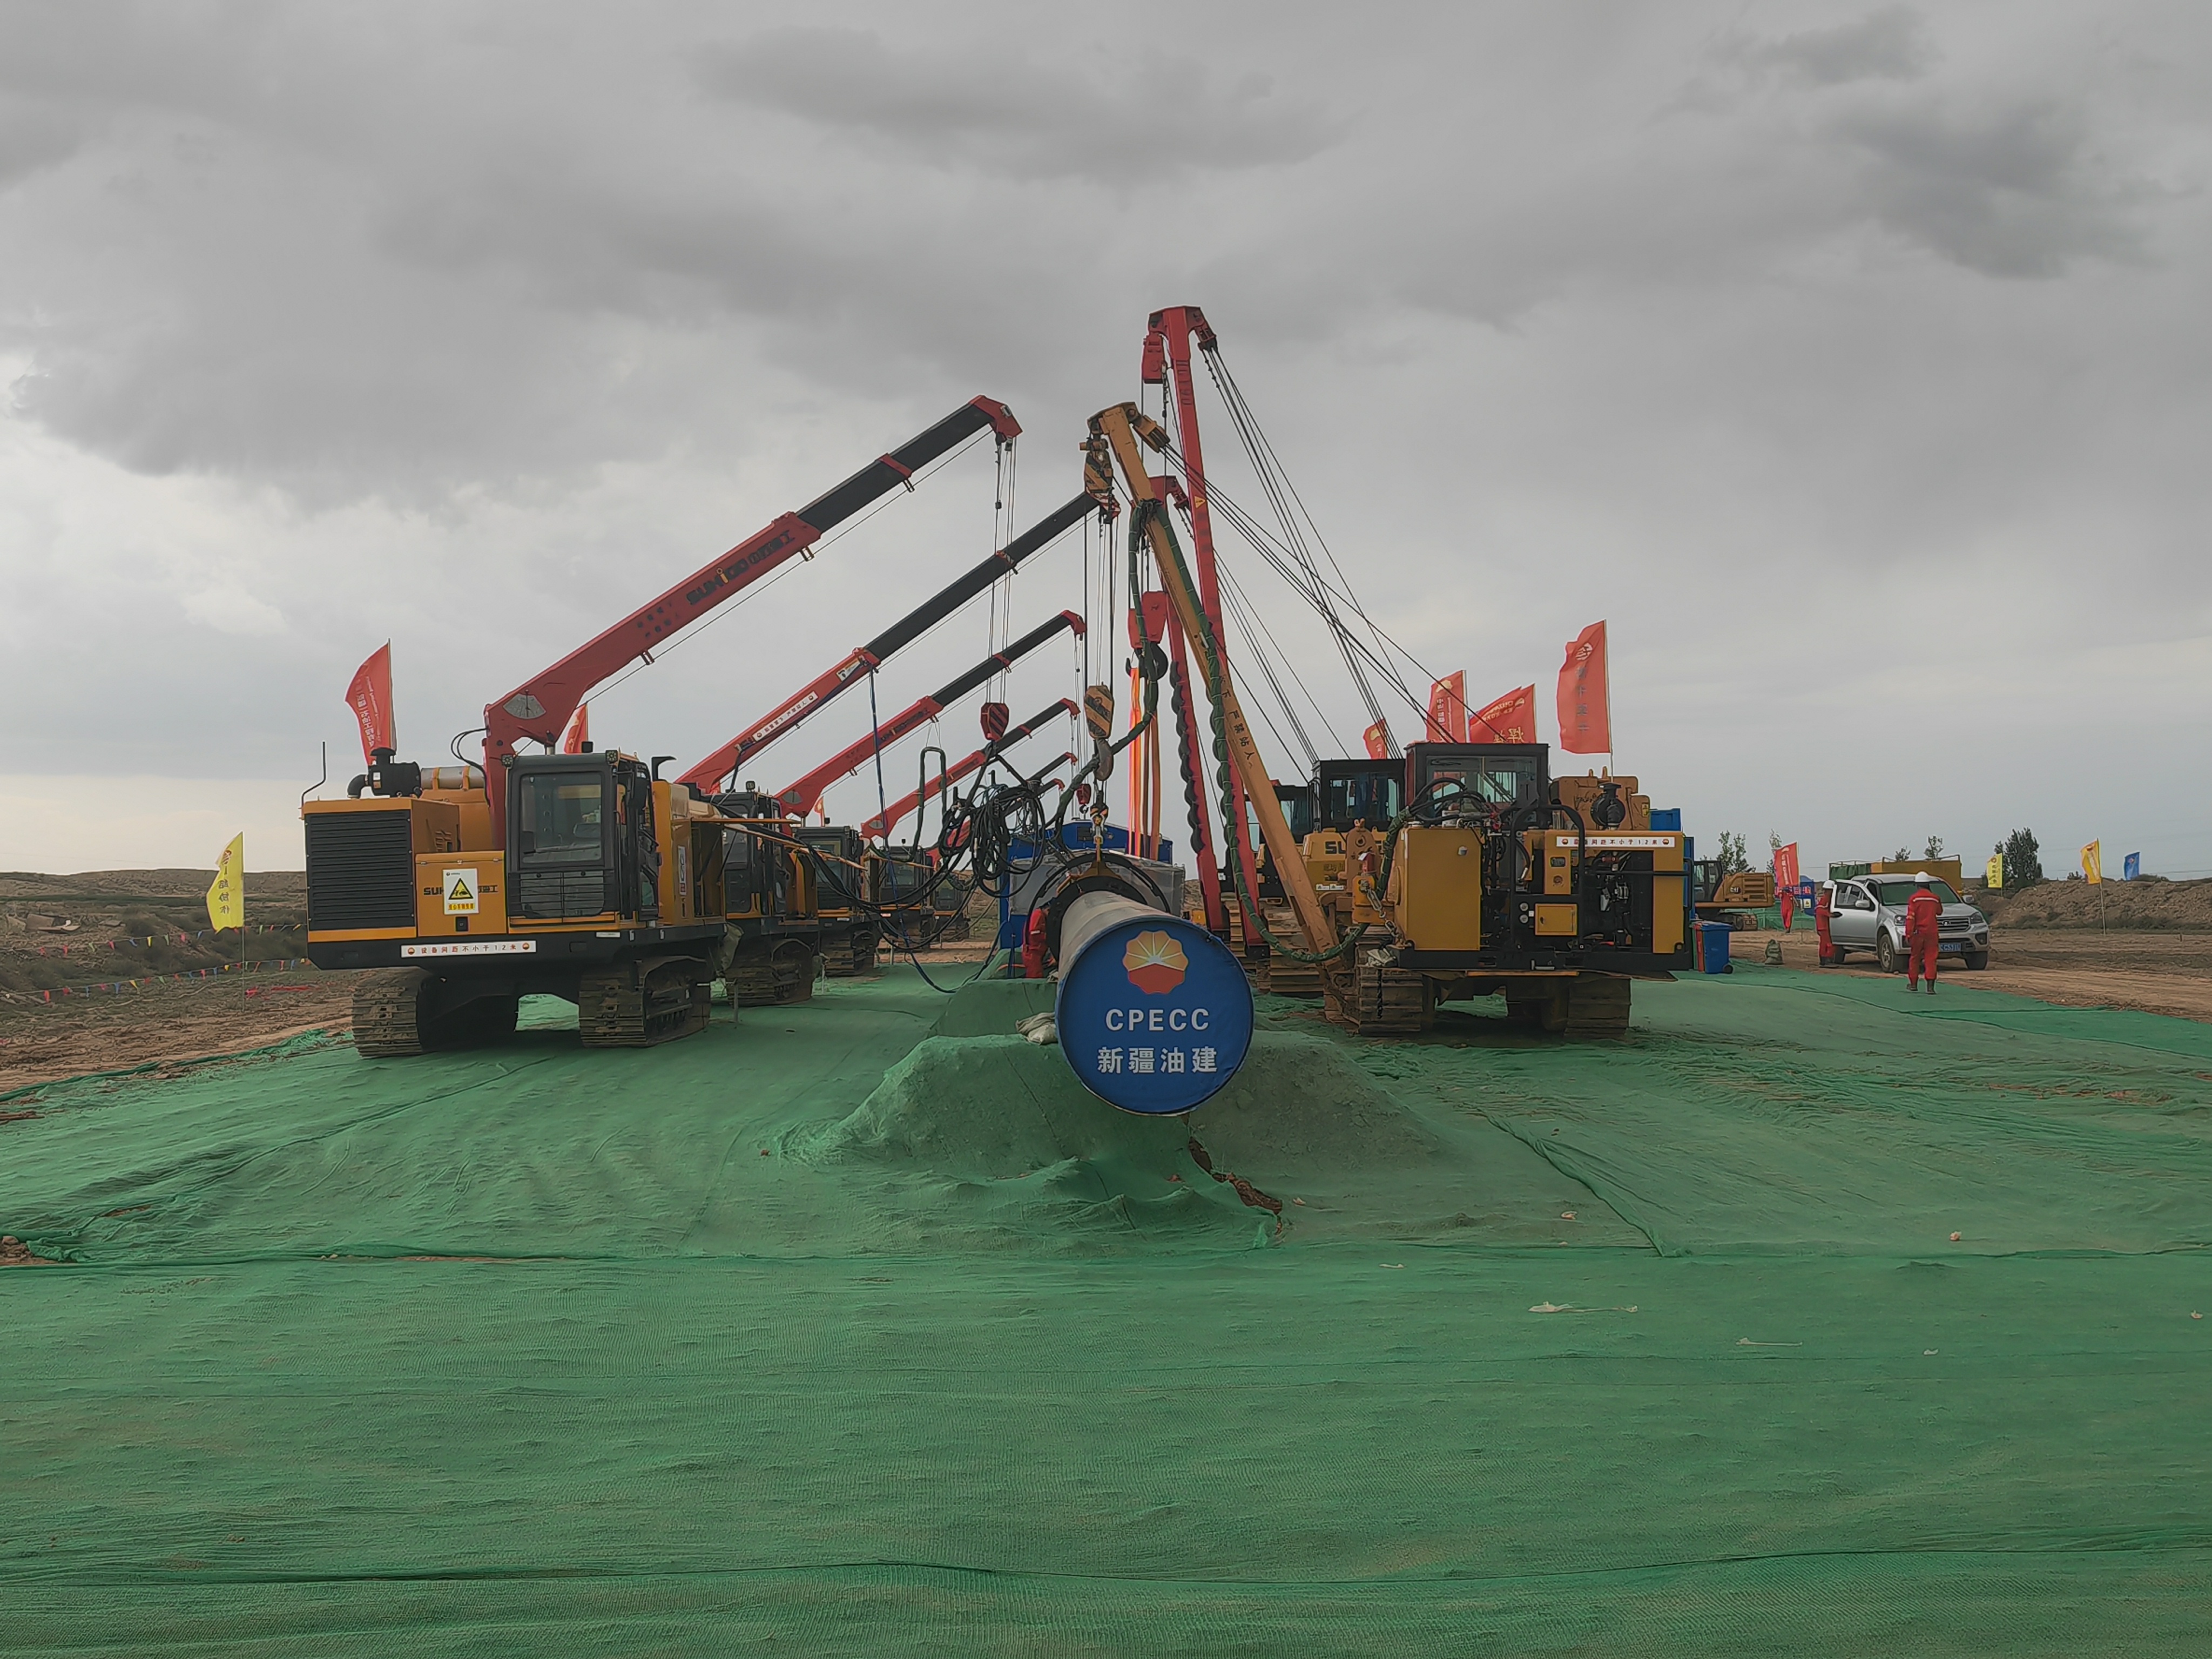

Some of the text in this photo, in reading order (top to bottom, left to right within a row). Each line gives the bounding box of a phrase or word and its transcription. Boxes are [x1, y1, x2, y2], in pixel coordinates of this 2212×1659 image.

[1105, 1009, 1210, 1031] CPECC
[1097, 1046, 1218, 1074] 新疆油建
